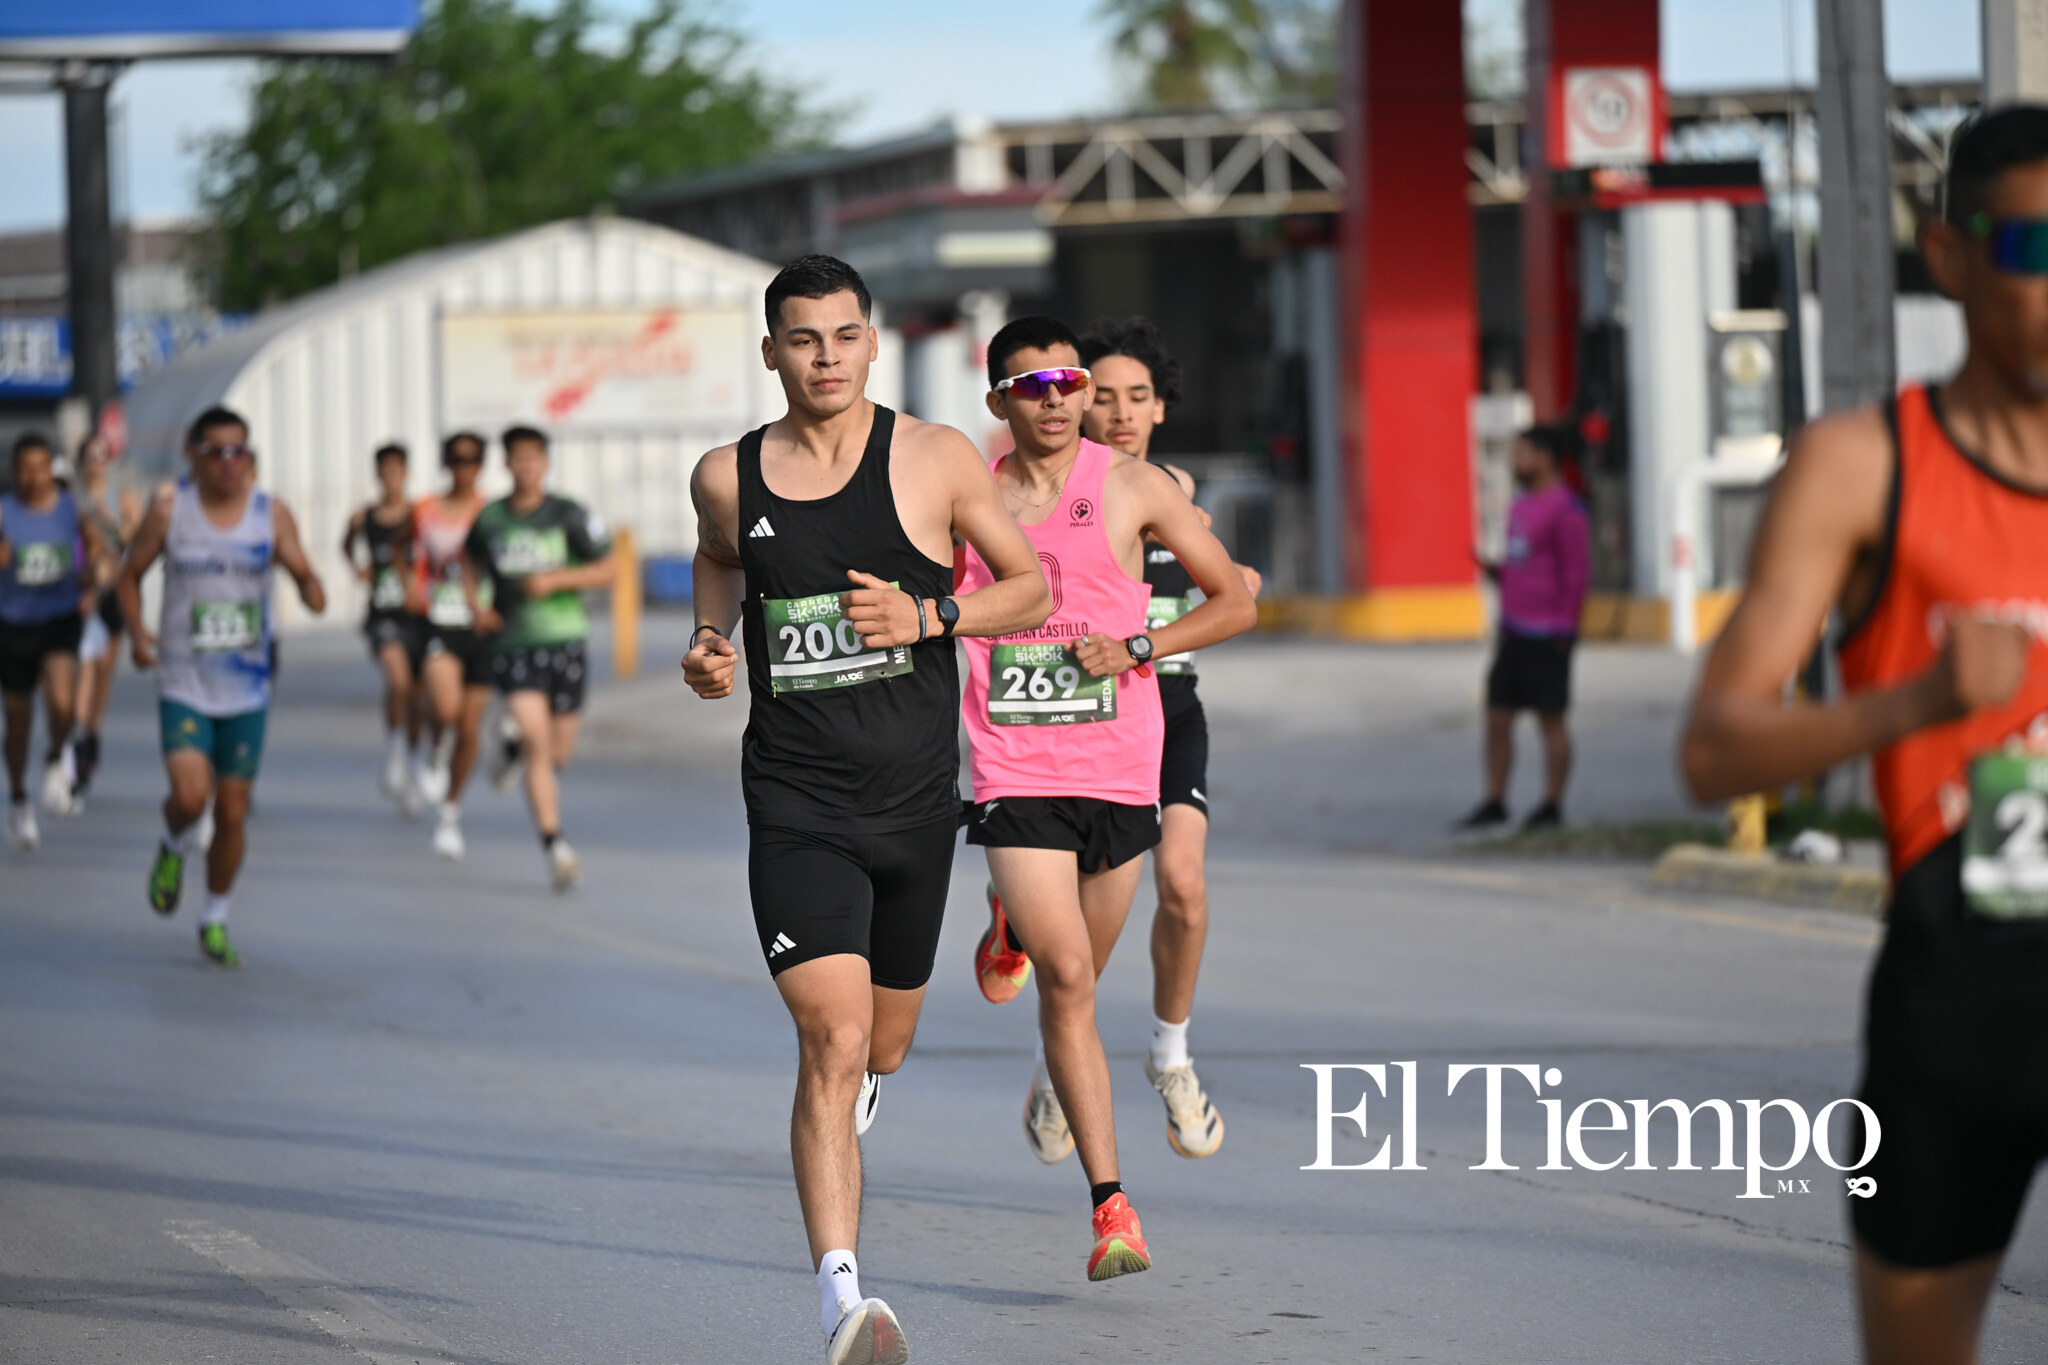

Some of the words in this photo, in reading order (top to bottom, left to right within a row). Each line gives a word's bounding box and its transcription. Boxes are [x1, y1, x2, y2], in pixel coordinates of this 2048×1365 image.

[787, 595, 839, 609] CARRERA
[1040, 622, 1089, 639] CASTILLO
[1002, 666, 1079, 700] 269
